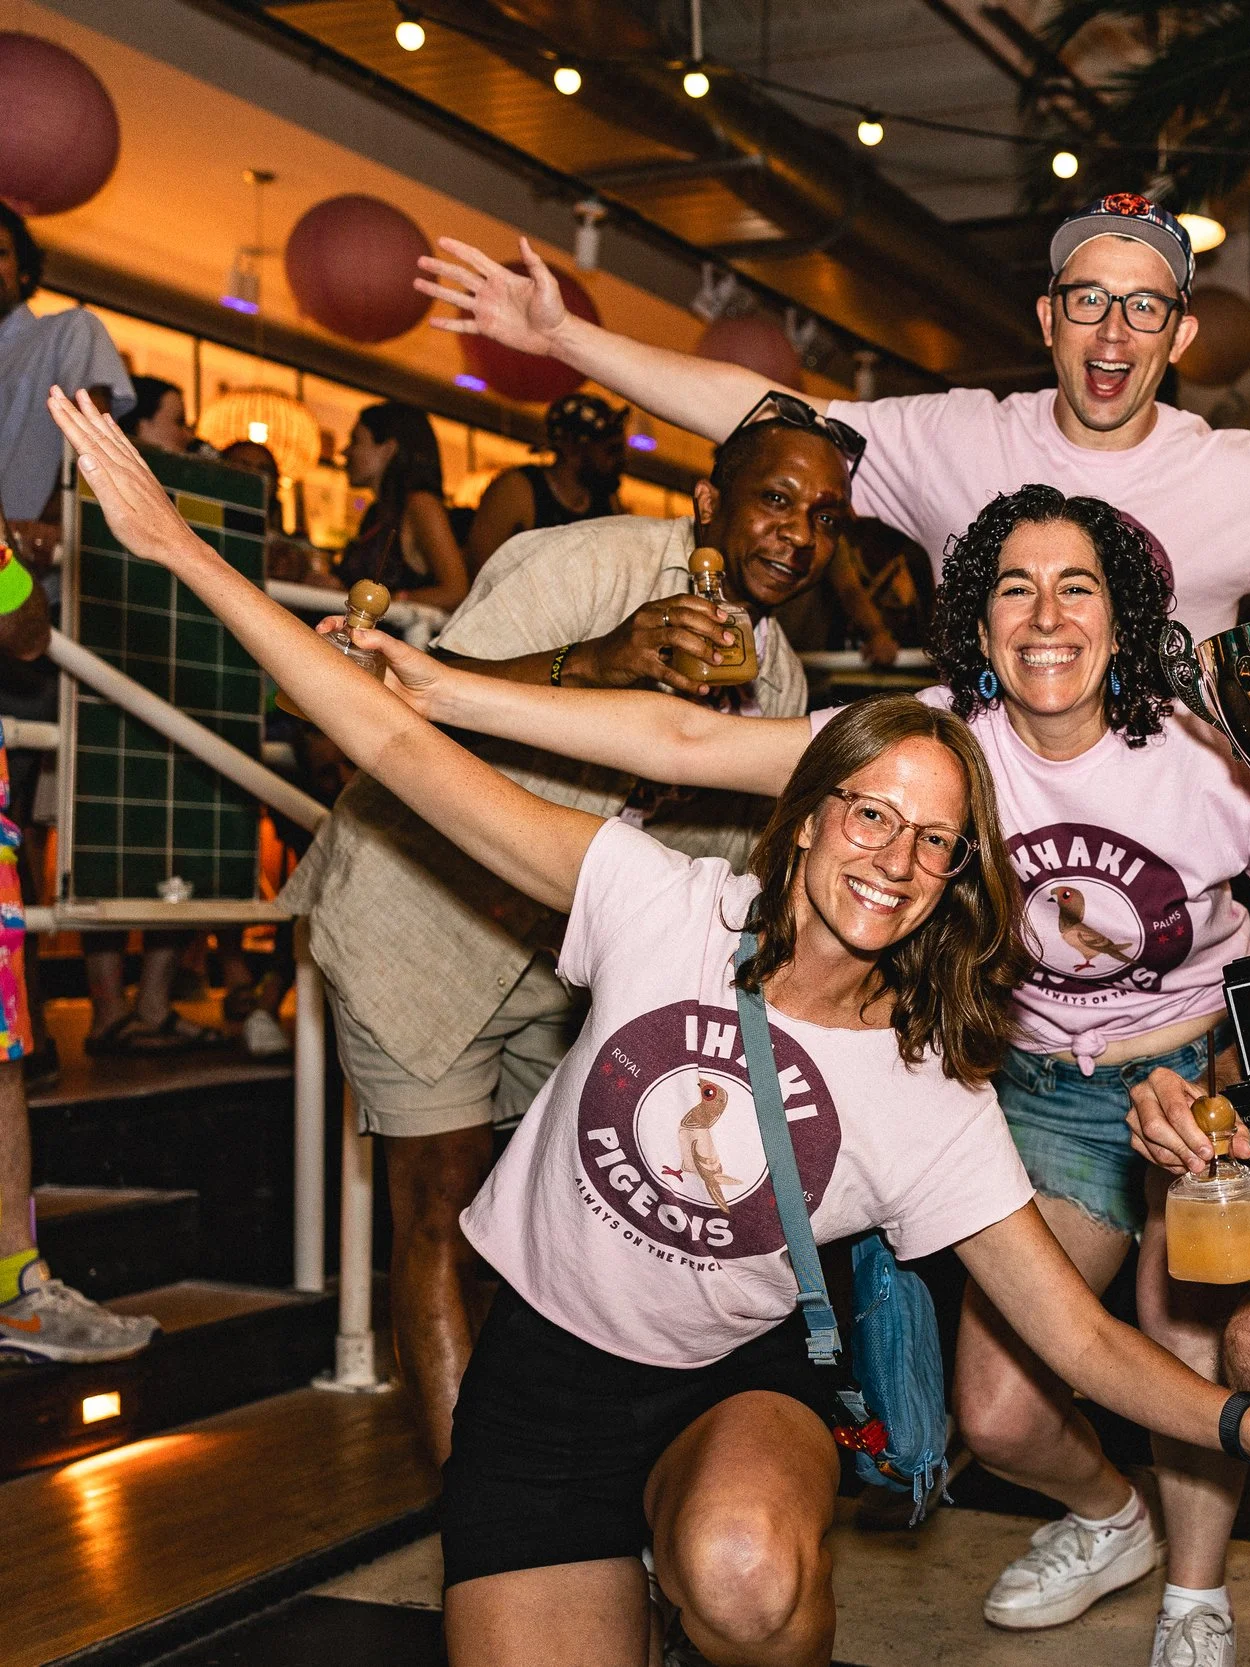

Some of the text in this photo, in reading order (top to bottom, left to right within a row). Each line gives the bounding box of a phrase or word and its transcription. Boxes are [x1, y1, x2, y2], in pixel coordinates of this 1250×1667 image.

[1010, 836, 1146, 886] KHAKI
[1153, 910, 1181, 931] PALMS
[1092, 996, 1108, 1005] ON
[611, 1047, 641, 1078] ROYAL
[575, 1177, 621, 1230] ALWAYS
[623, 1230, 643, 1246] ON
[648, 1244, 675, 1263] THE
